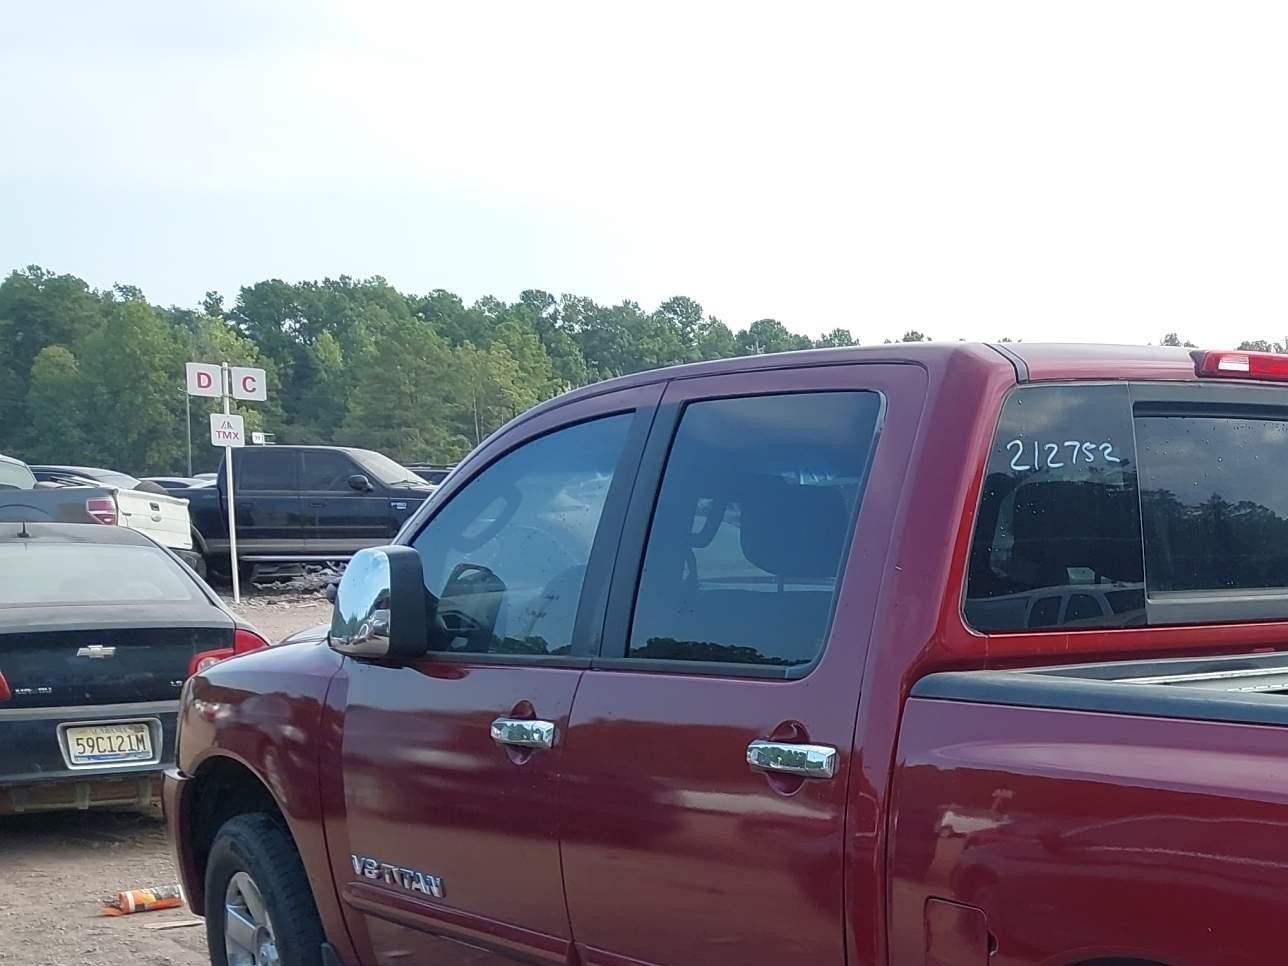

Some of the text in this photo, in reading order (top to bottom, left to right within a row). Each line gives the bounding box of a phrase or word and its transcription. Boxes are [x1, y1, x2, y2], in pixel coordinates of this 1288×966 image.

[197, 372, 212, 389] D
[242, 376, 257, 393] C
[216, 430, 240, 440] TMX
[1006, 439, 1121, 471] 212752
[75, 733, 147, 755] 59C121M
[351, 854, 444, 898] V8 TITAN
